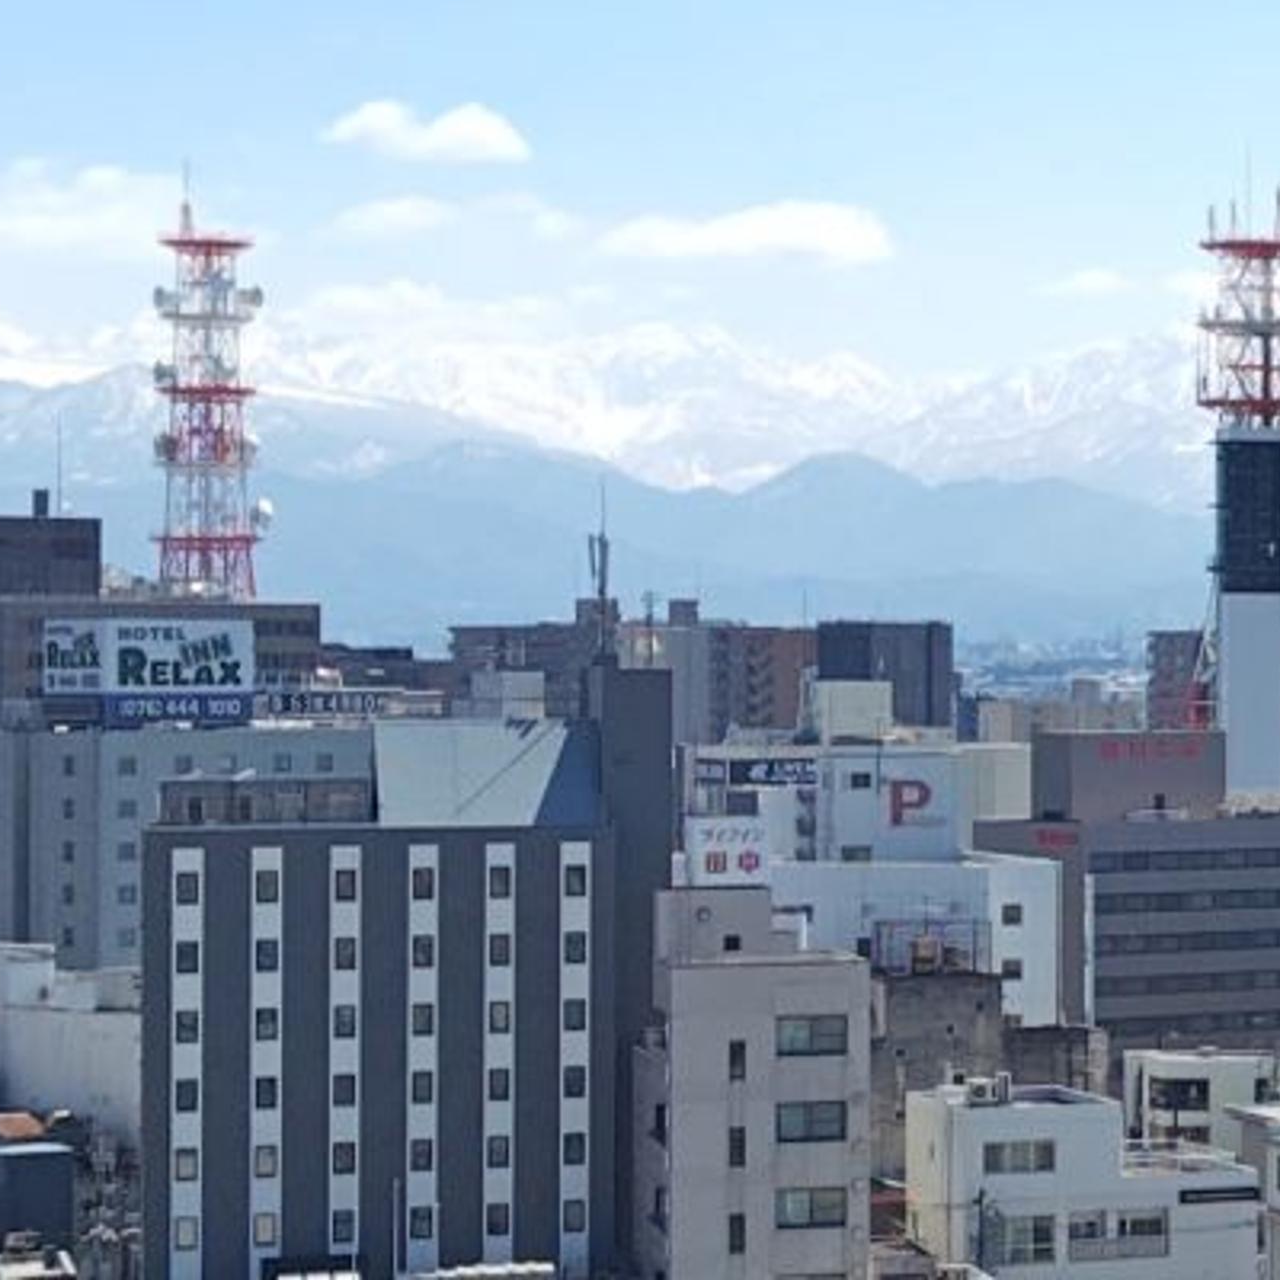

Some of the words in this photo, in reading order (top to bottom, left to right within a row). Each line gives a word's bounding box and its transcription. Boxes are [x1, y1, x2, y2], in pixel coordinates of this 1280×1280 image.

[118, 626, 186, 641] HOTEL
[178, 632, 234, 669] INN
[118, 646, 242, 686] RELAX
[890, 779, 932, 827] P
